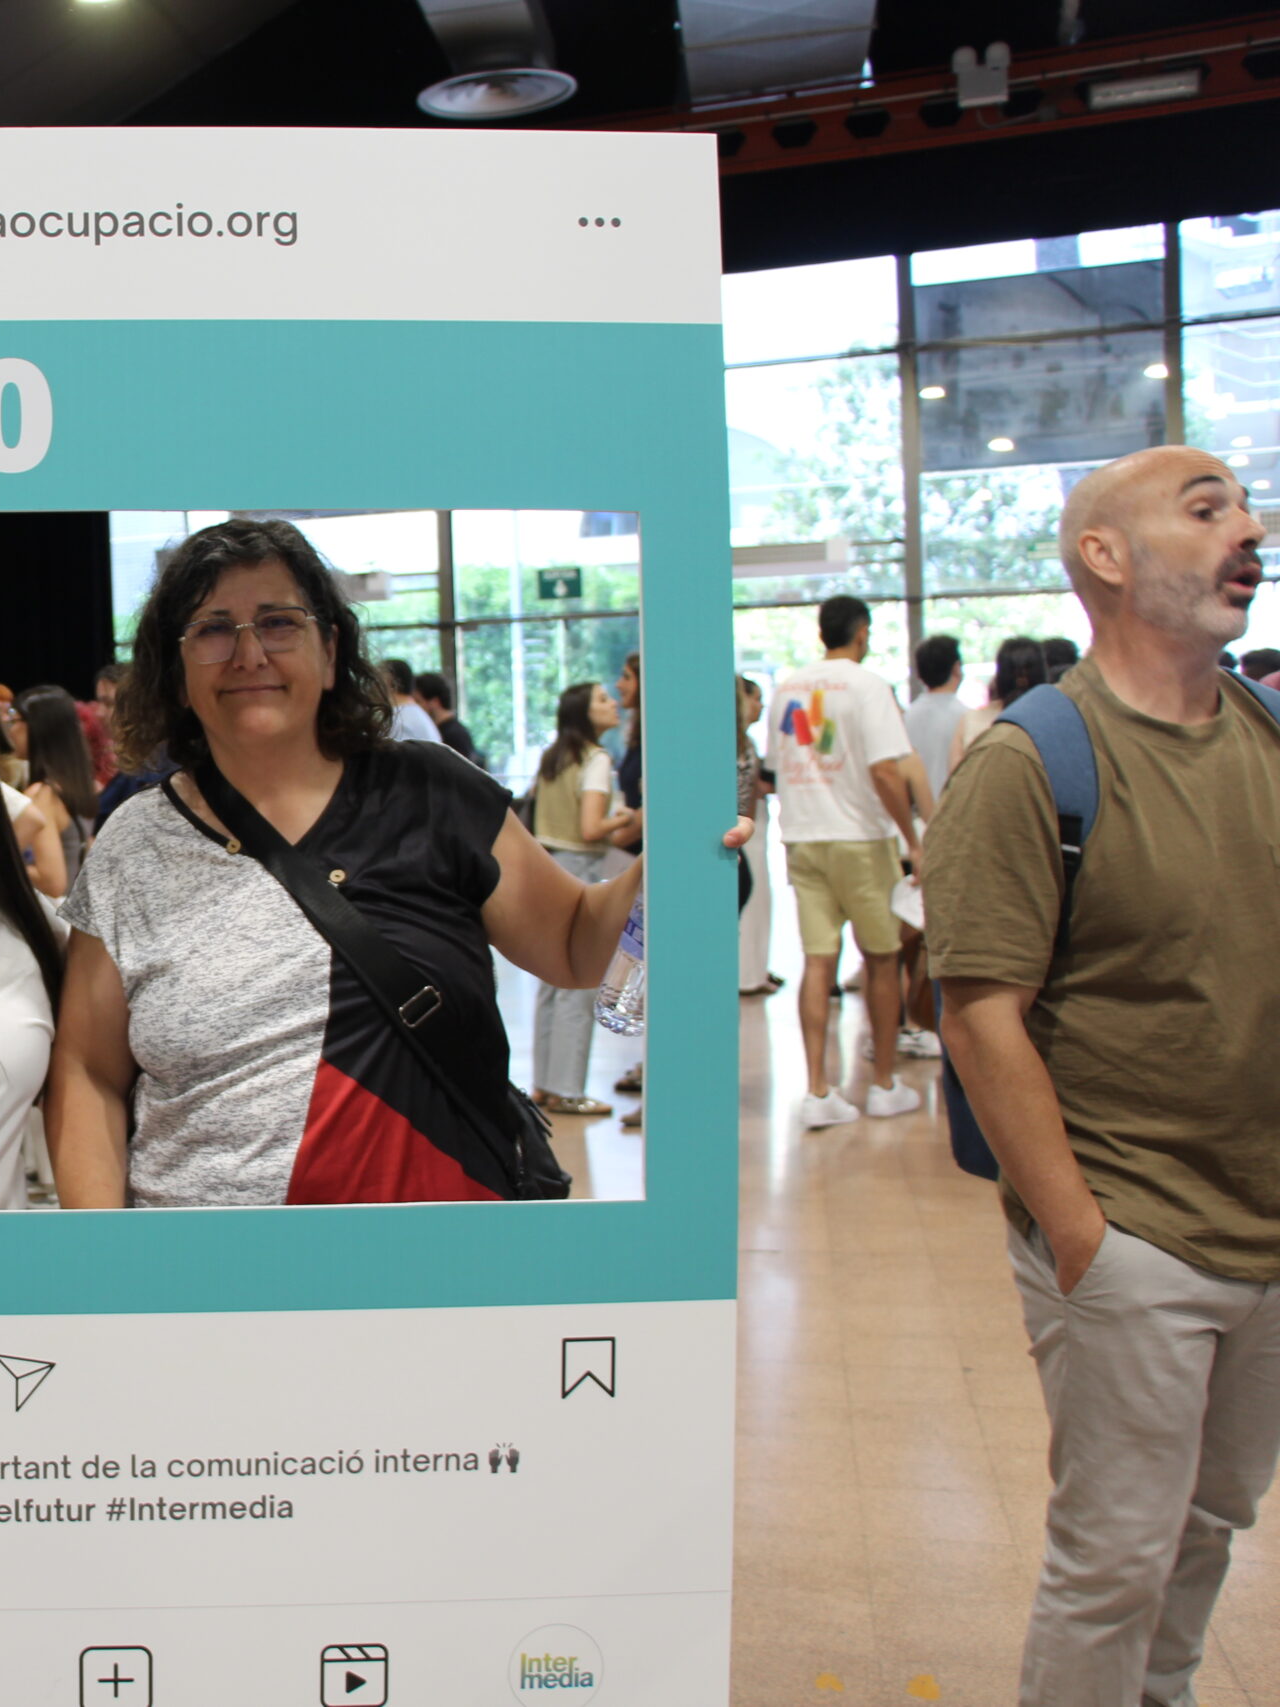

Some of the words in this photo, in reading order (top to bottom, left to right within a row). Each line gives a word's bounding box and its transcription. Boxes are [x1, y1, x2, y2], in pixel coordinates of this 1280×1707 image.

[81, 1454, 121, 1480] de
[131, 1453, 157, 1479] la
[166, 1449, 365, 1479] comunicació
[374, 1448, 479, 1474] interna
[105, 1494, 294, 1522] #Intermedia
[519, 1652, 578, 1673] Inter
[519, 1667, 594, 1689] media
